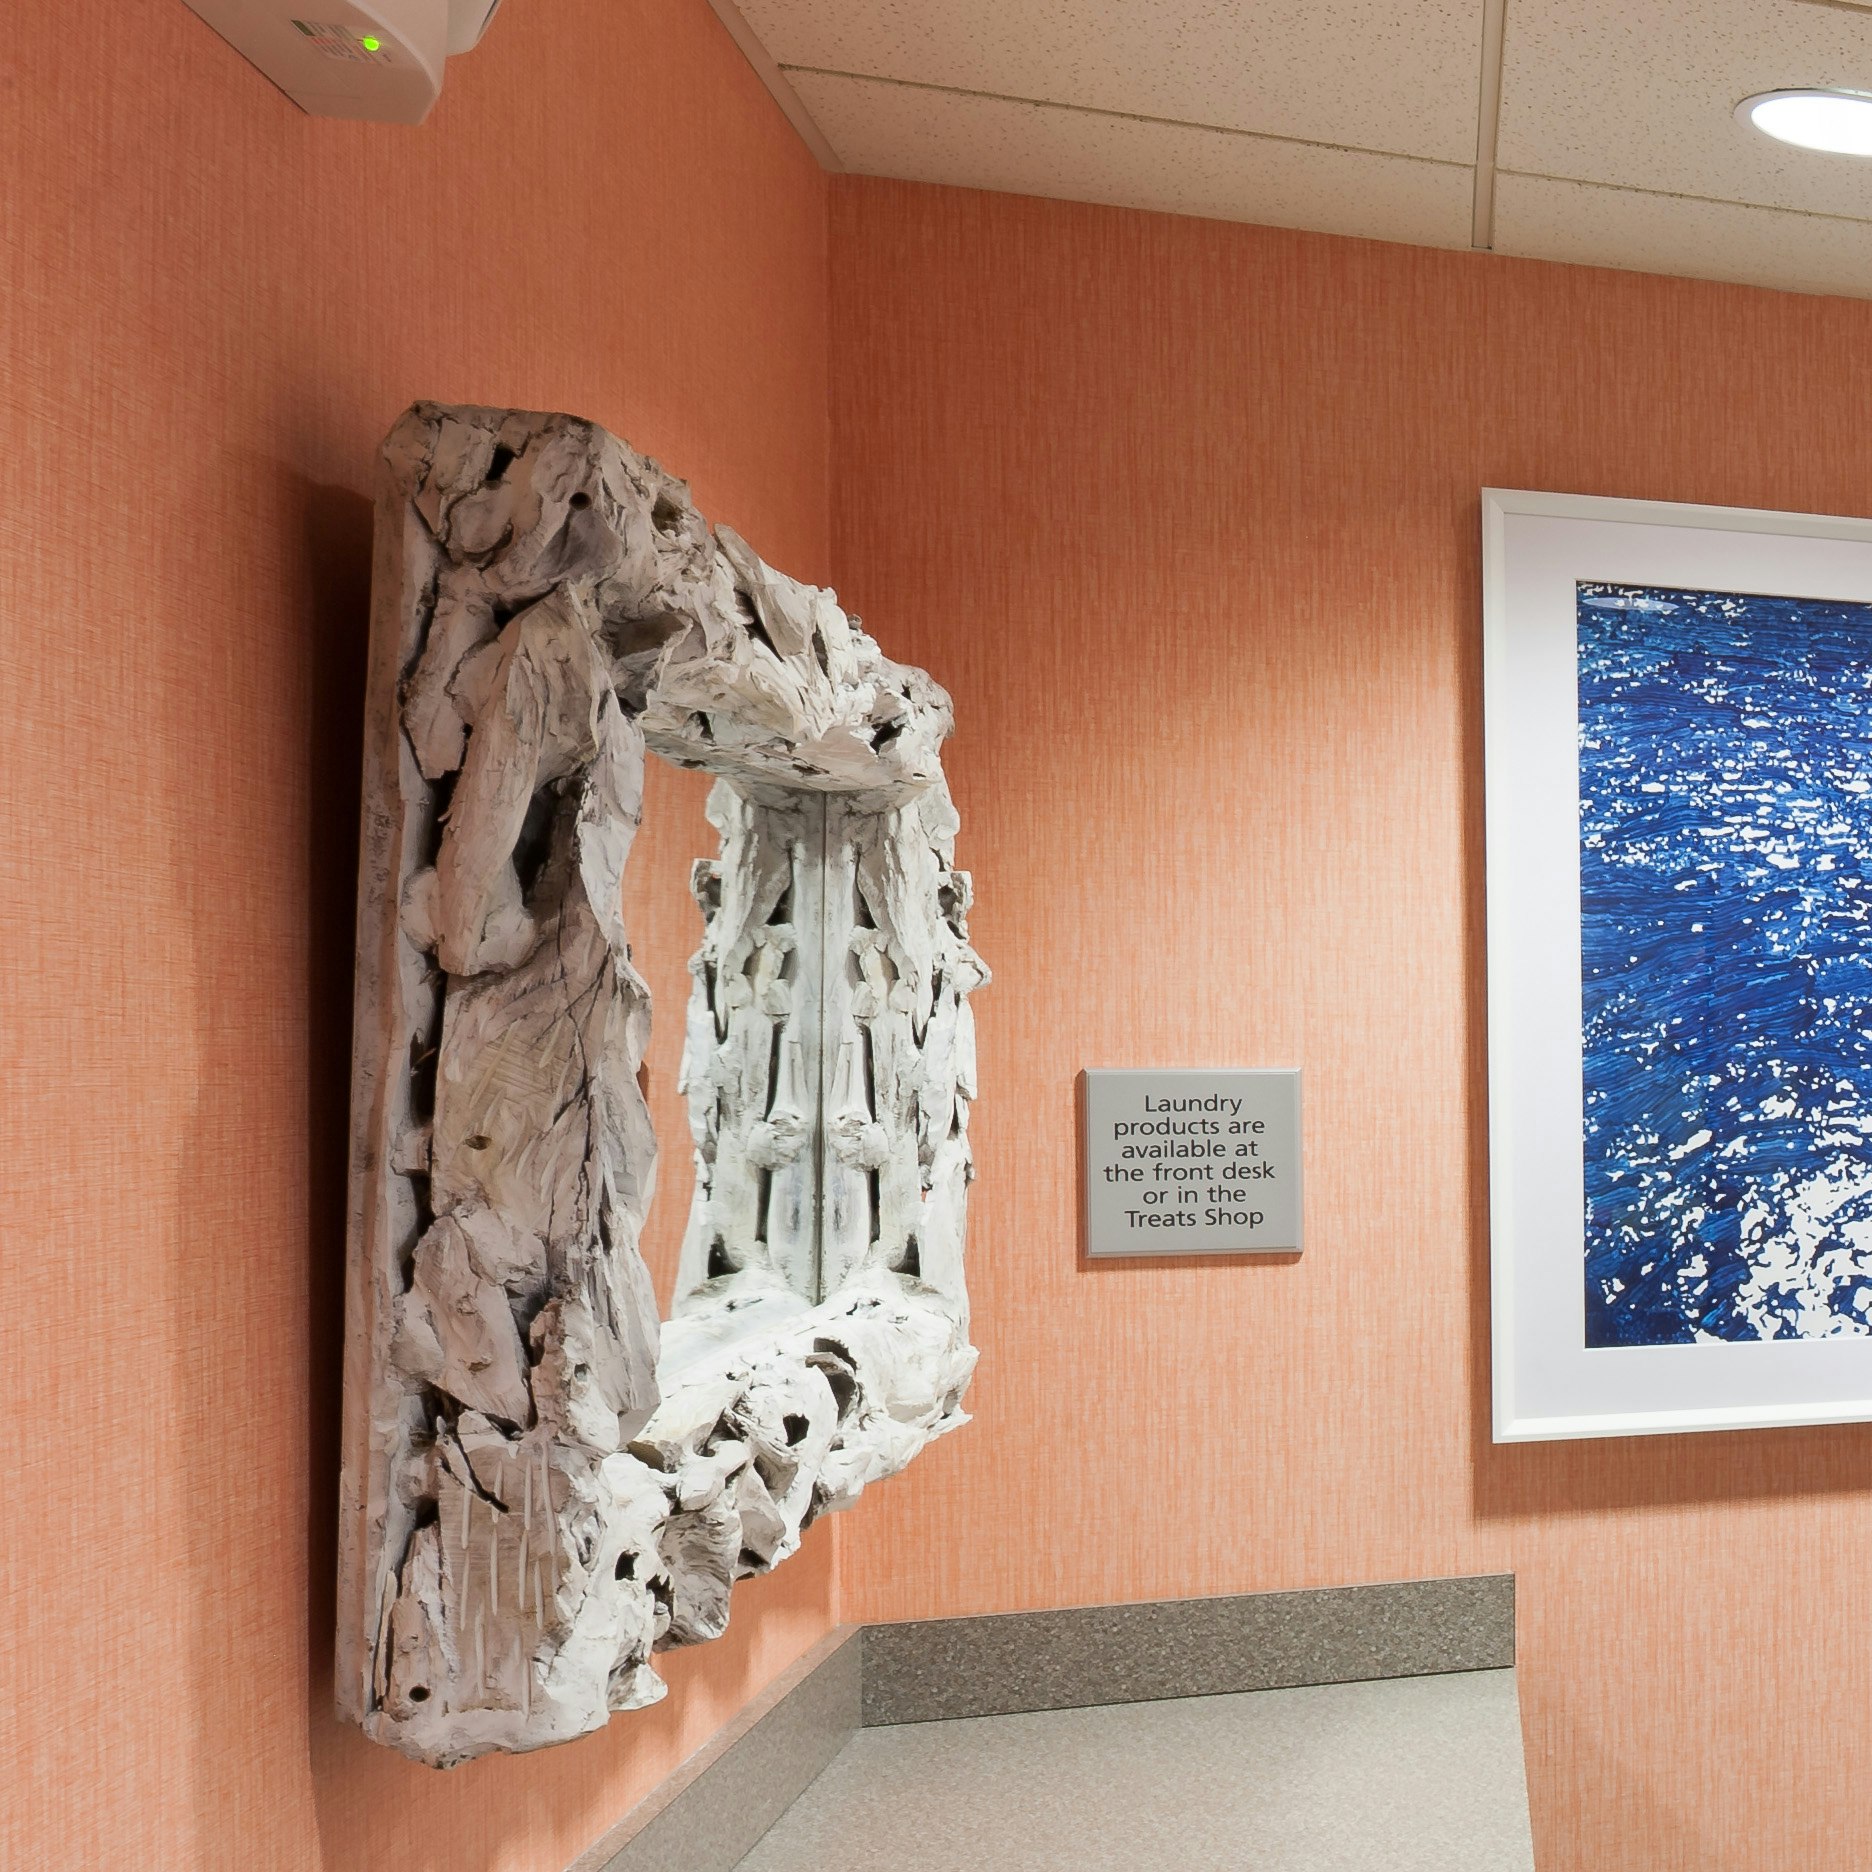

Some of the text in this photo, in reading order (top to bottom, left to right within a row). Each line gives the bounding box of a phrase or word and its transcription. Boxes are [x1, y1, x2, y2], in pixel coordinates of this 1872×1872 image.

[1145, 1094, 1242, 1116] Laundry
[1114, 1117, 1265, 1140] products are
[1121, 1139, 1258, 1159] available at
[1103, 1161, 1275, 1182] the front desk
[1143, 1185, 1246, 1204] or in the
[1125, 1207, 1264, 1229] Treats Shop
